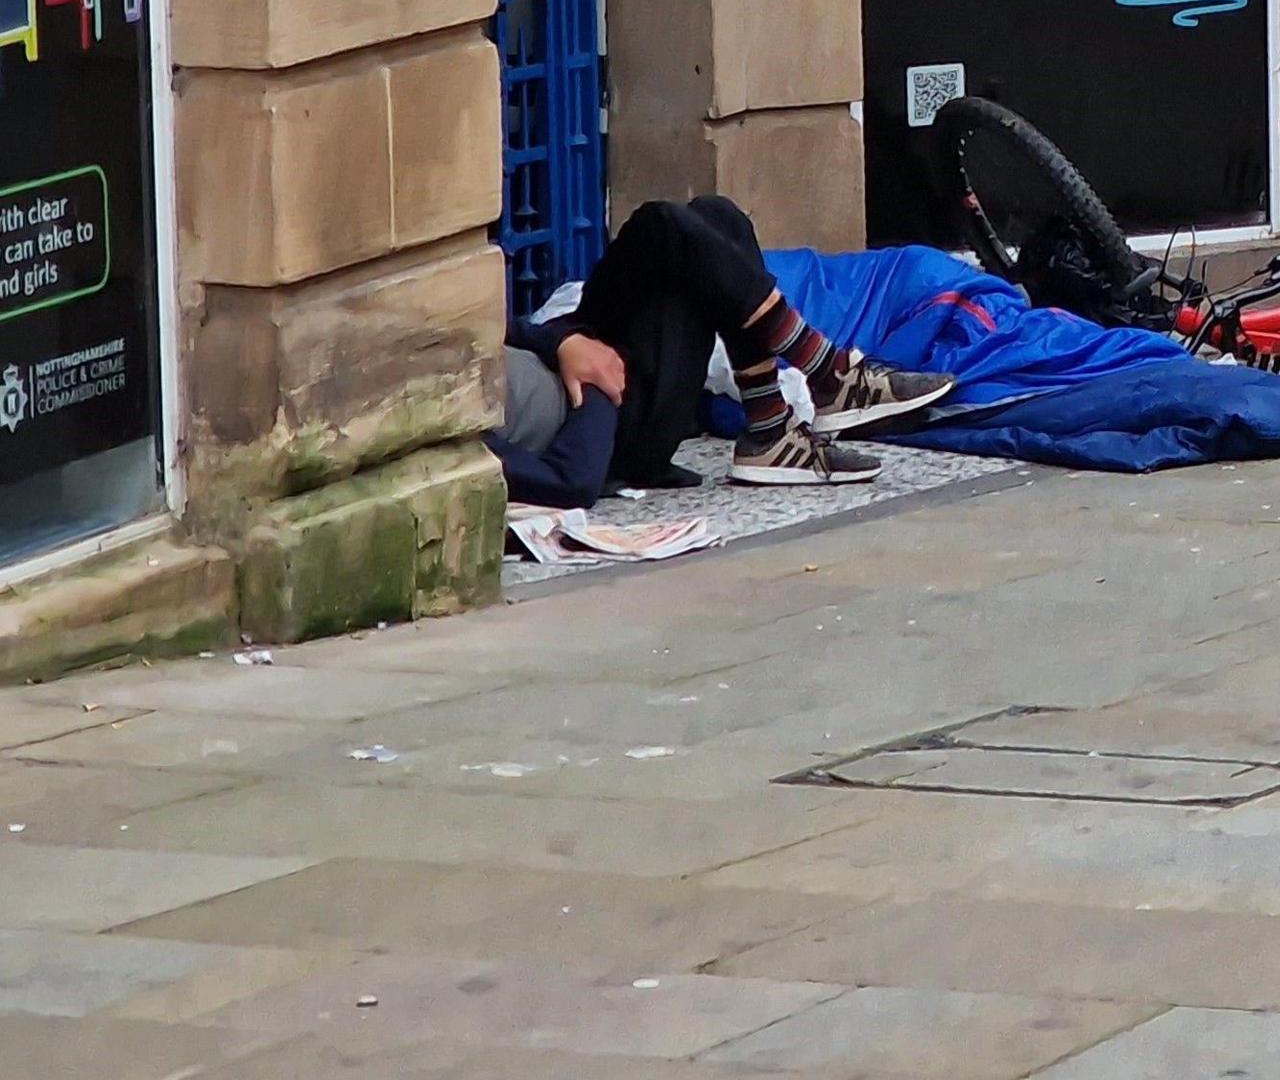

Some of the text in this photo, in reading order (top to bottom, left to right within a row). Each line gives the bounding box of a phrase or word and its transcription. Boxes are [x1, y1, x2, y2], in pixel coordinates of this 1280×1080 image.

[0, 198, 68, 233] ith clear
[5, 222, 93, 264] can take to
[0, 260, 58, 298] nd girls
[37, 368, 77, 397] POLICE
